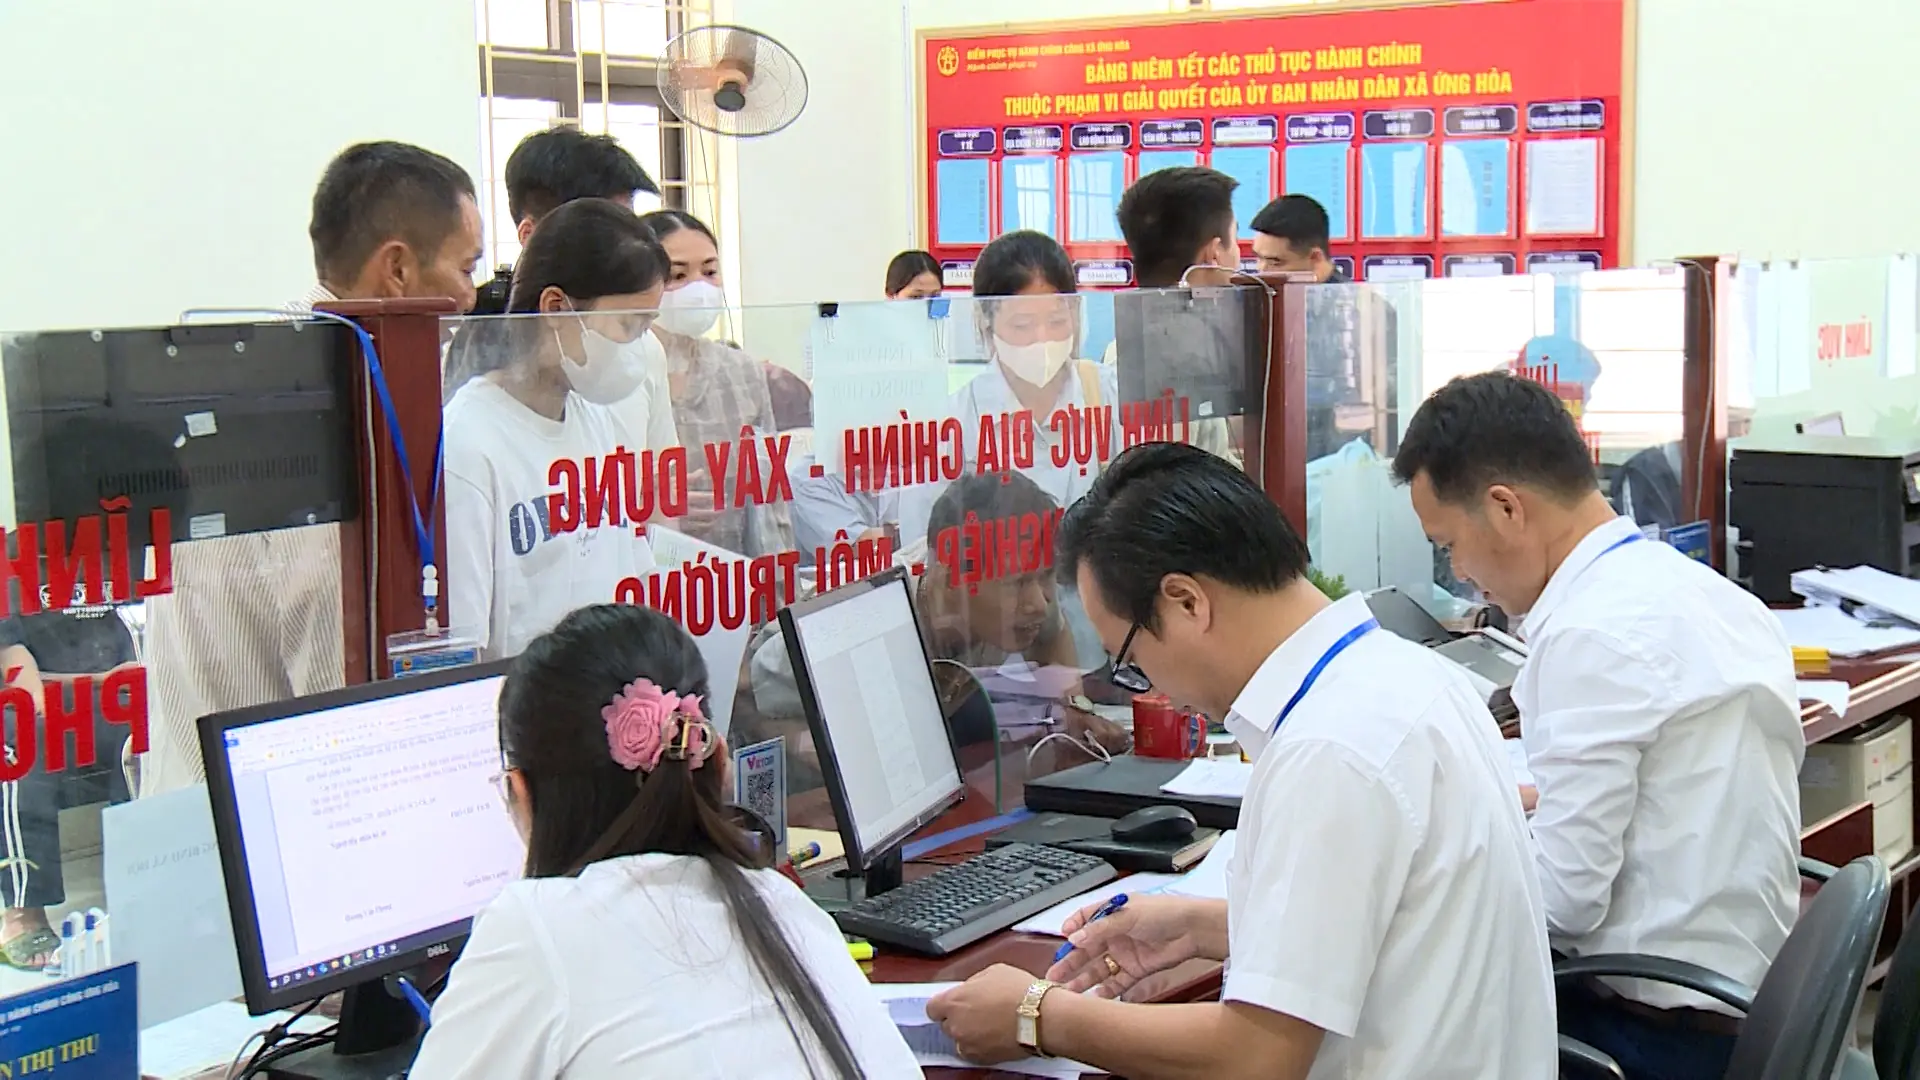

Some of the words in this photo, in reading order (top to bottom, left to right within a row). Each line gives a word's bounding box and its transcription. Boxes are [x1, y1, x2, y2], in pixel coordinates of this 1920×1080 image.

[1085, 58, 1128, 84] BẢNG
[1131, 56, 1173, 81] NIÊM
[1177, 51, 1205, 78] YẾT
[1208, 52, 1240, 77] CÁC
[1244, 46, 1275, 74] THỦ
[1279, 51, 1312, 76] TỤC
[1316, 45, 1363, 70] HÀNH
[1367, 41, 1422, 67] CHÍNH
[1004, 92, 1051, 118] THUỘC
[1055, 94, 1099, 118] PHẠM
[1104, 93, 1118, 112] VI
[1122, 84, 1154, 111] GIẢI
[1158, 82, 1207, 111] QUYẾT
[1209, 80, 1242, 107] CỦA
[1246, 78, 1267, 105] ỦY
[1271, 82, 1307, 104] BAN
[1311, 76, 1359, 101] NHÂN
[1363, 73, 1399, 99] DÂN
[1404, 71, 1428, 97] XÃ
[1432, 70, 1471, 96] ỨNG
[427, 943, 450, 959] DELL
[18, 1046, 56, 1075] THỊ
[59, 1033, 101, 1064] THU
